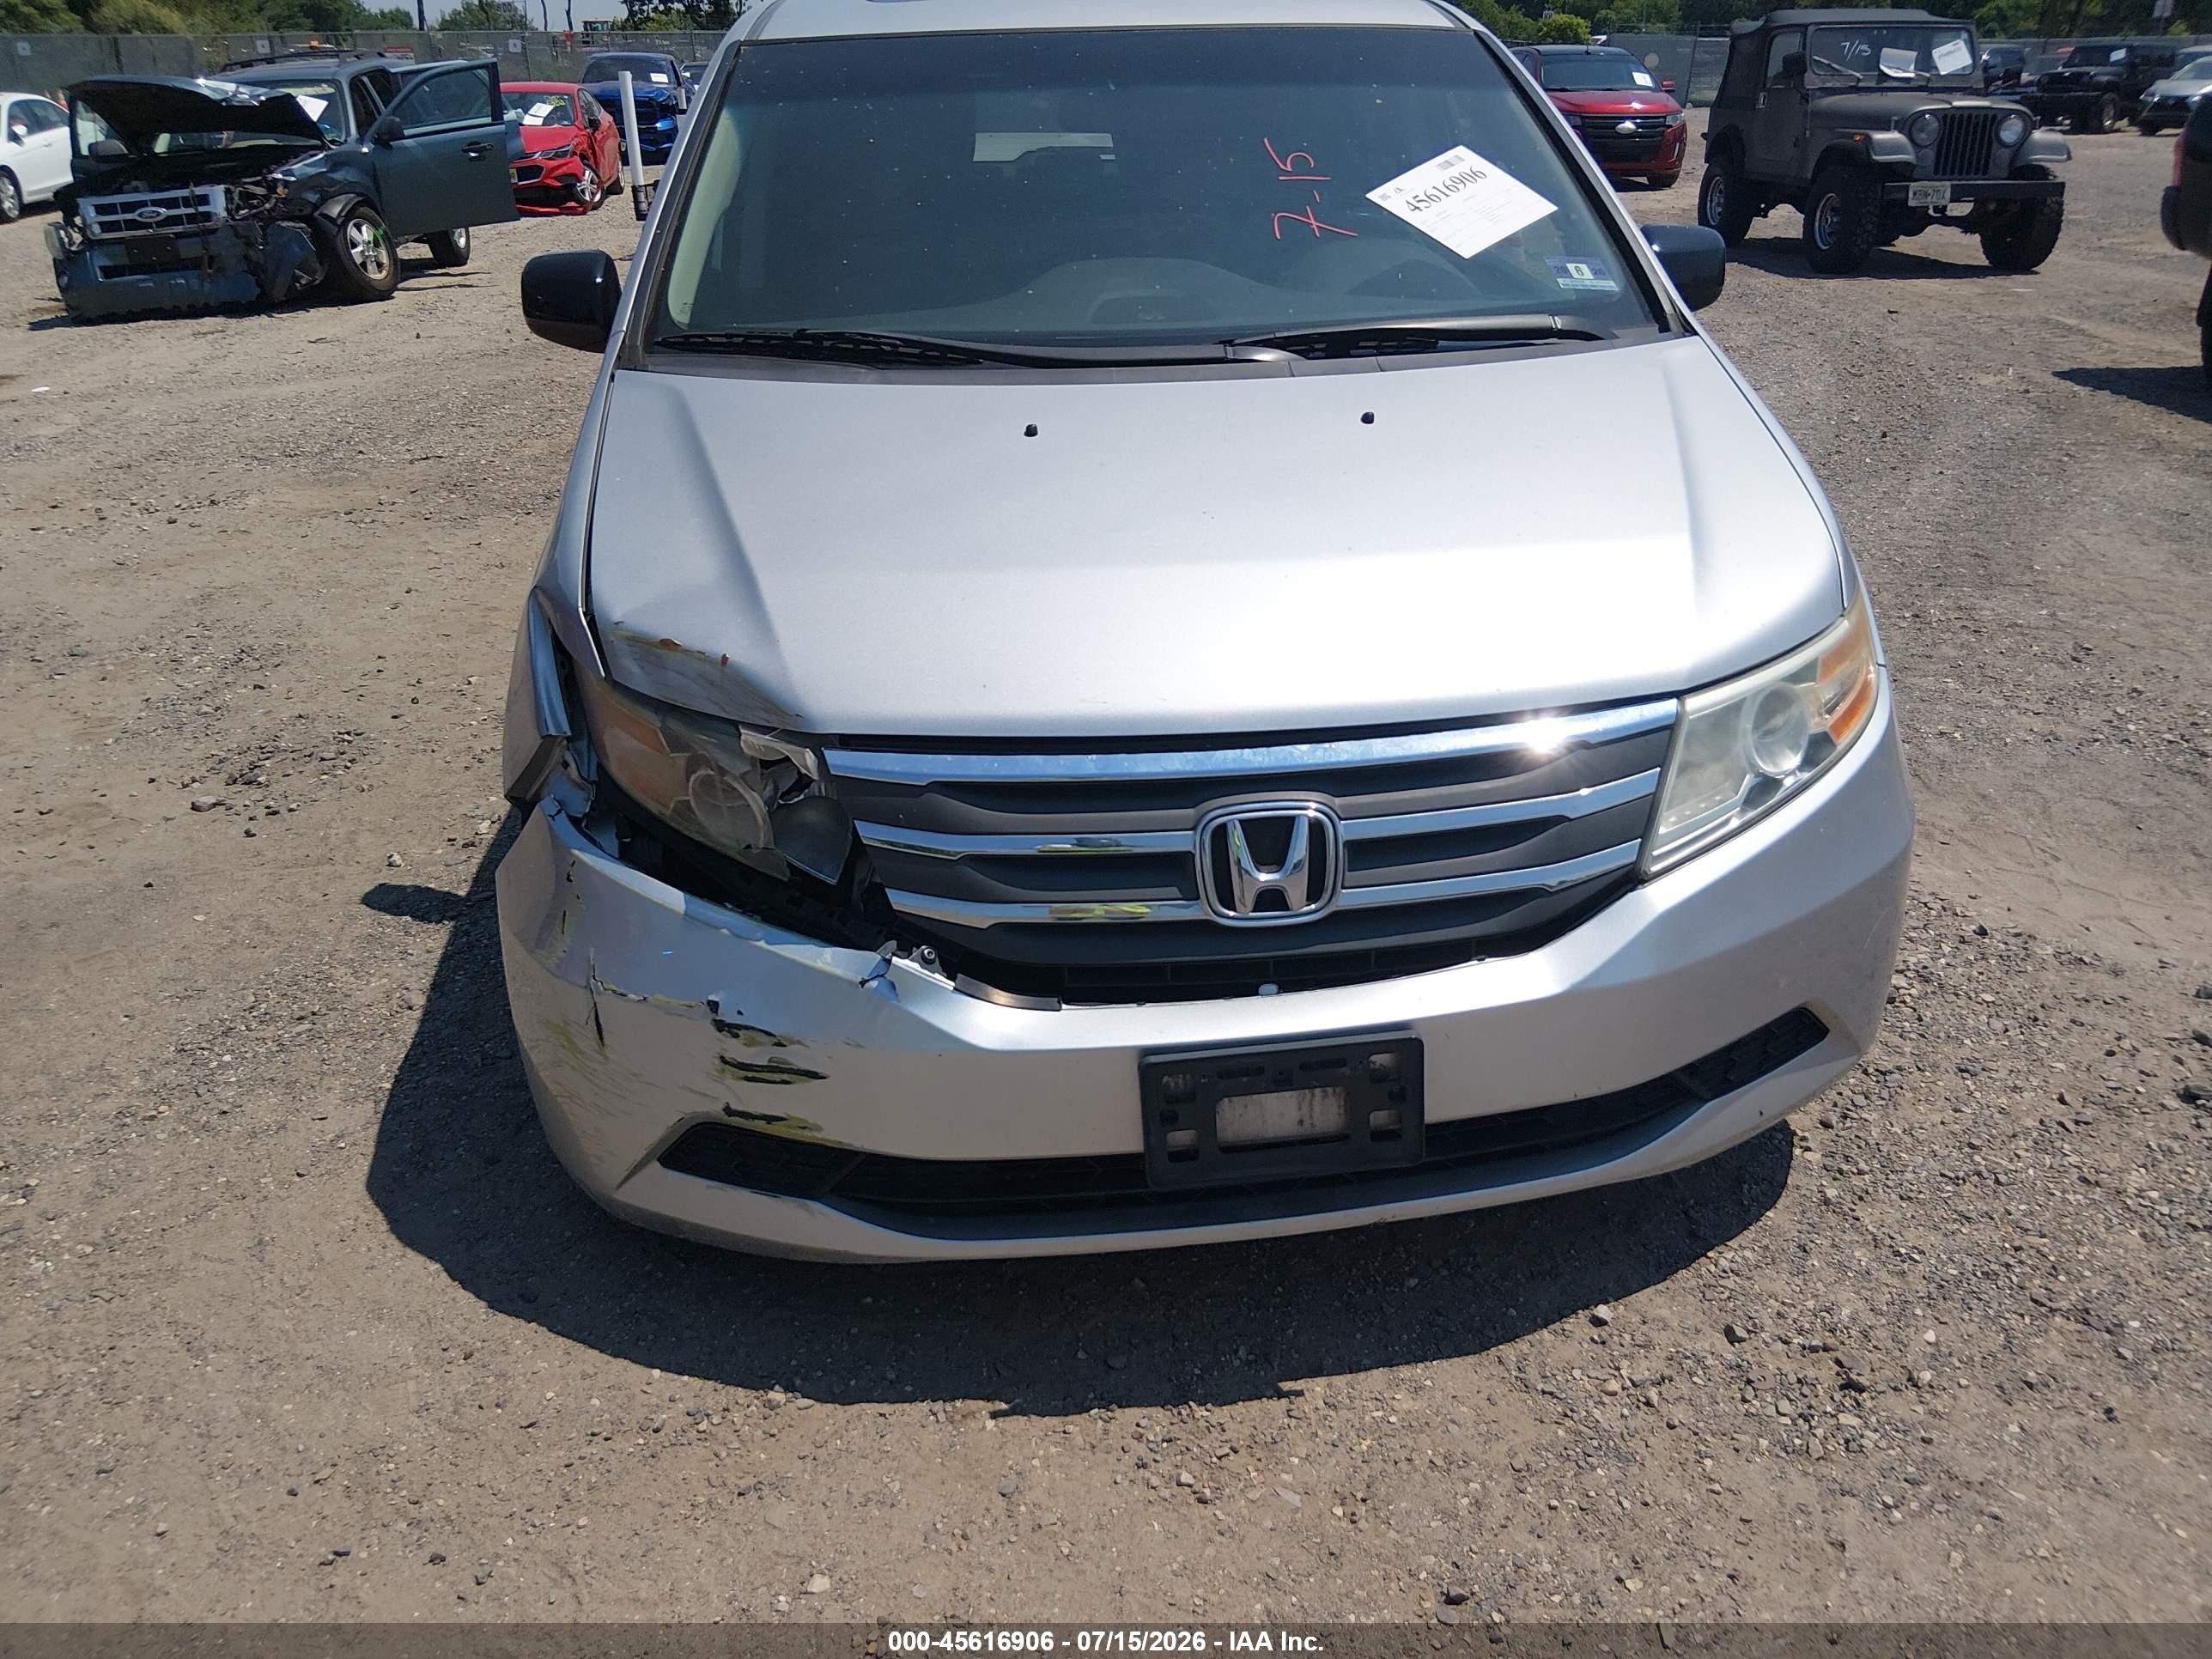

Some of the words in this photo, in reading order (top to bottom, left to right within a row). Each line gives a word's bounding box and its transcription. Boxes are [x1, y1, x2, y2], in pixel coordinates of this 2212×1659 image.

[1840, 39, 1872, 62] 7/15
[1264, 137, 1359, 240] 7-15
[1405, 165, 1487, 214] 45616906
[1573, 265, 1585, 276] 6
